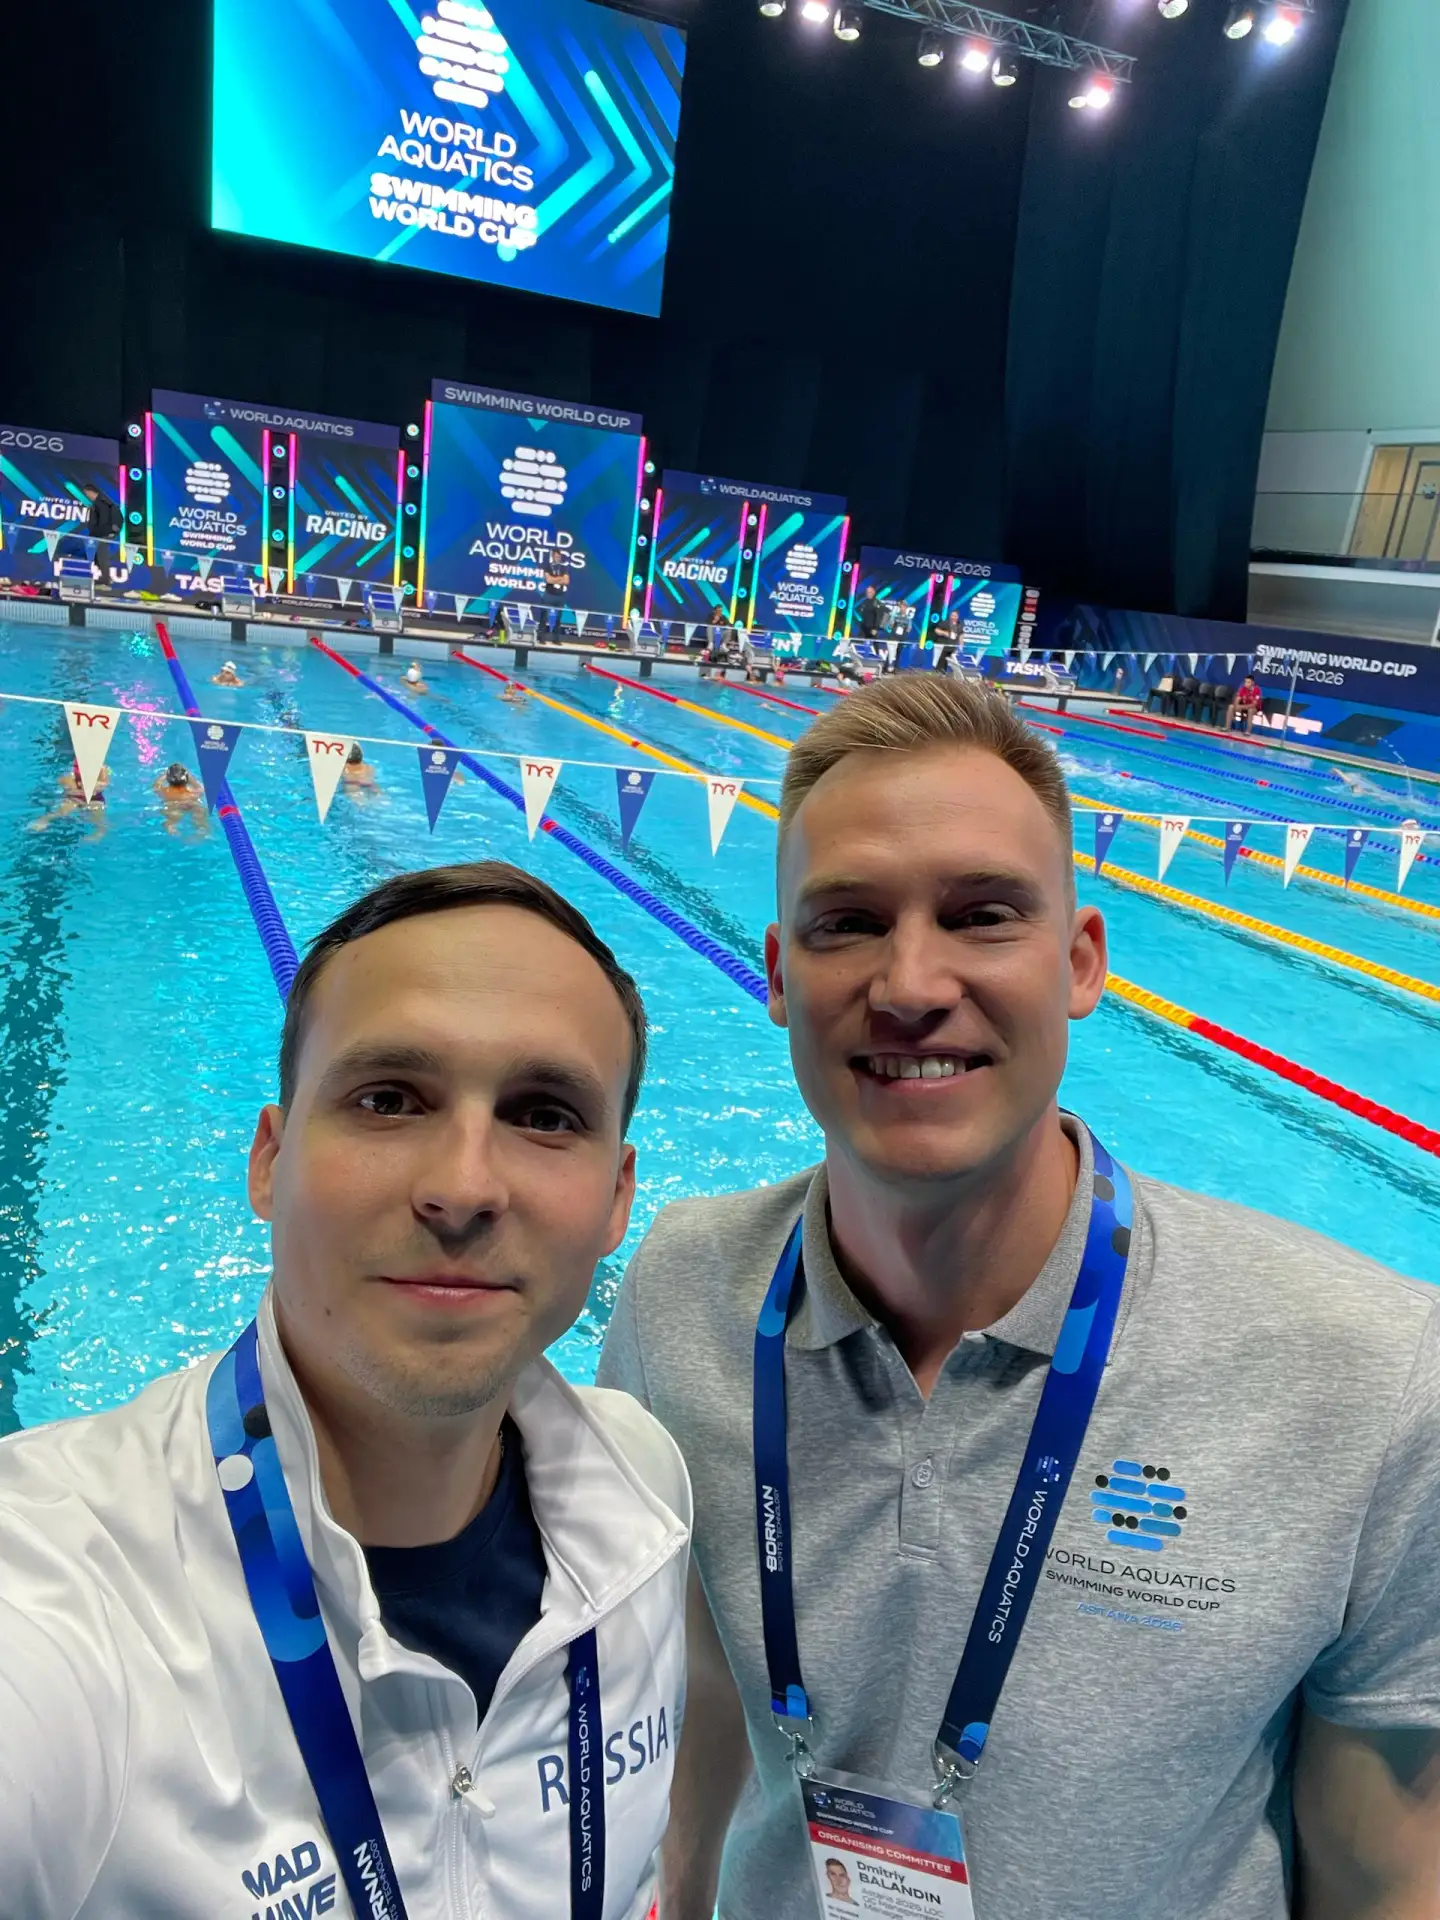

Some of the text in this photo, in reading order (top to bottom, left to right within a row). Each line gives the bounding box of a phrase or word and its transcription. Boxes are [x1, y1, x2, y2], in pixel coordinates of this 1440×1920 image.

[400, 109, 517, 158] WORLD
[377, 135, 534, 192] AQUATICS
[369, 172, 538, 229] SWIMMING
[369, 197, 538, 250] WORLD CUP
[444, 387, 631, 430] SWIMMING WORLD CUP
[230, 408, 354, 437] WORLD AQUATICS
[0, 430, 64, 453] 2026
[719, 484, 812, 507] WORLD AQUATICS
[20, 500, 91, 523] RACIN
[178, 506, 237, 523] WORLD
[325, 510, 356, 519] UNITED
[169, 517, 247, 536] AQUATICS
[306, 514, 387, 541] RACING
[486, 522, 573, 548] WORLD
[180, 539, 236, 551] WORLD CUP
[489, 563, 545, 578] SWIMMI
[663, 561, 728, 584] RACING
[894, 555, 991, 577] ASTANA 2026
[484, 575, 536, 591] WORLD
[777, 582, 819, 595] WORLD
[769, 591, 824, 605] AQUATICS
[963, 626, 999, 636] QUATICS
[964, 619, 995, 629] WORLD
[1256, 644, 1417, 678] SWIMMING WORLD CUP
[1306, 668, 1345, 686] 2026
[72, 711, 111, 730] TYR
[312, 740, 345, 756] TYR
[525, 764, 554, 779] TYR
[711, 783, 737, 796] TYR
[1164, 820, 1184, 832] TYR
[1290, 828, 1309, 840] TYR
[1405, 835, 1421, 845] TYR
[762, 1484, 778, 1573] BORNAN
[988, 1491, 1048, 1644] WORLD AQUATICS
[1121, 1565, 1236, 1593] AQUATICS
[1046, 1569, 1220, 1611] SWIMMING WORLD CUP
[537, 1706, 669, 1813] RSSIA
[577, 1702, 592, 1892] WORLD AQUATICS
[833, 1796, 865, 1809] WORLD
[835, 1805, 876, 1819] AQUATICS
[818, 1831, 952, 1874] ORGANISING COMMITTEE
[242, 1841, 321, 1900] MAD
[856, 1861, 905, 1884] Dmitriy
[860, 1872, 942, 1905] BALANDIN
